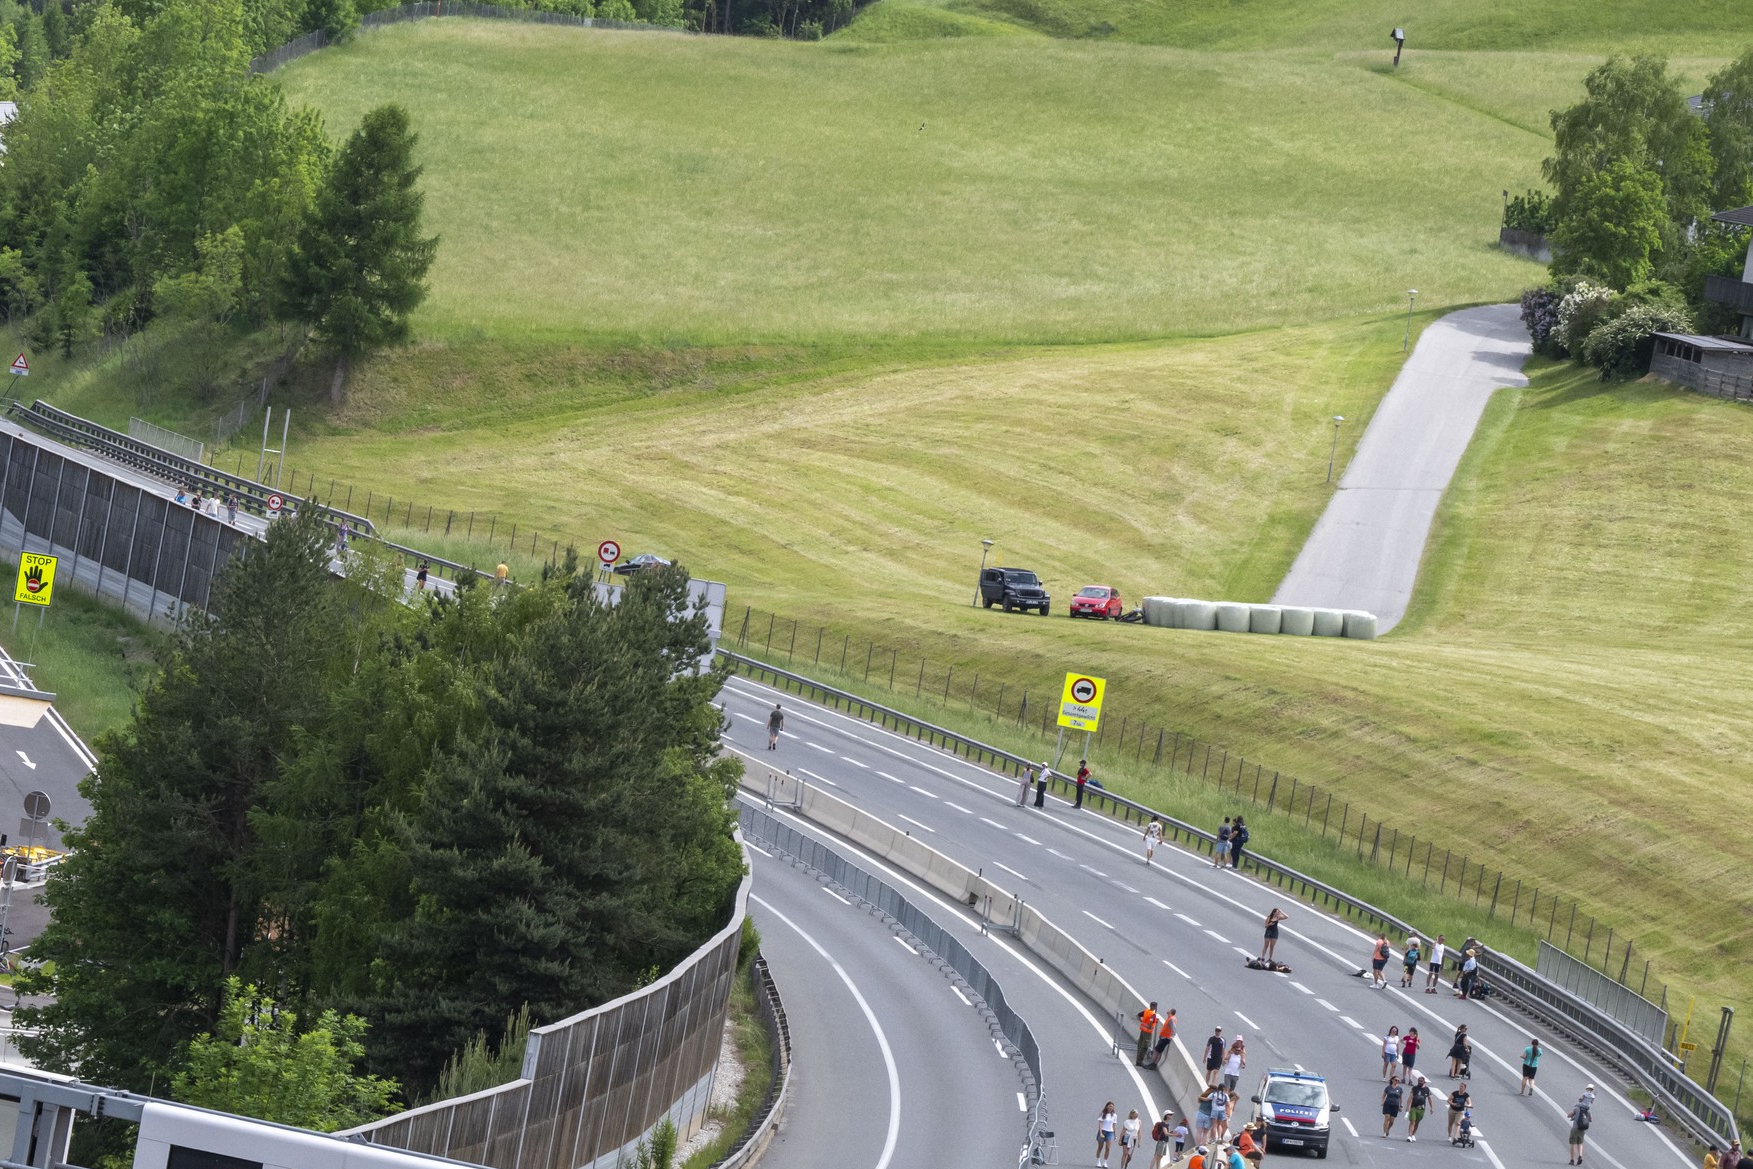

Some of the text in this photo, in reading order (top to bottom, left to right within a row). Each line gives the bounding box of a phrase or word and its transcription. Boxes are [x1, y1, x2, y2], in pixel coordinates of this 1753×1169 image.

[26, 555, 52, 566] STOP
[19, 592, 47, 602] FALSCH
[1279, 1108, 1313, 1116] POLIZEI
